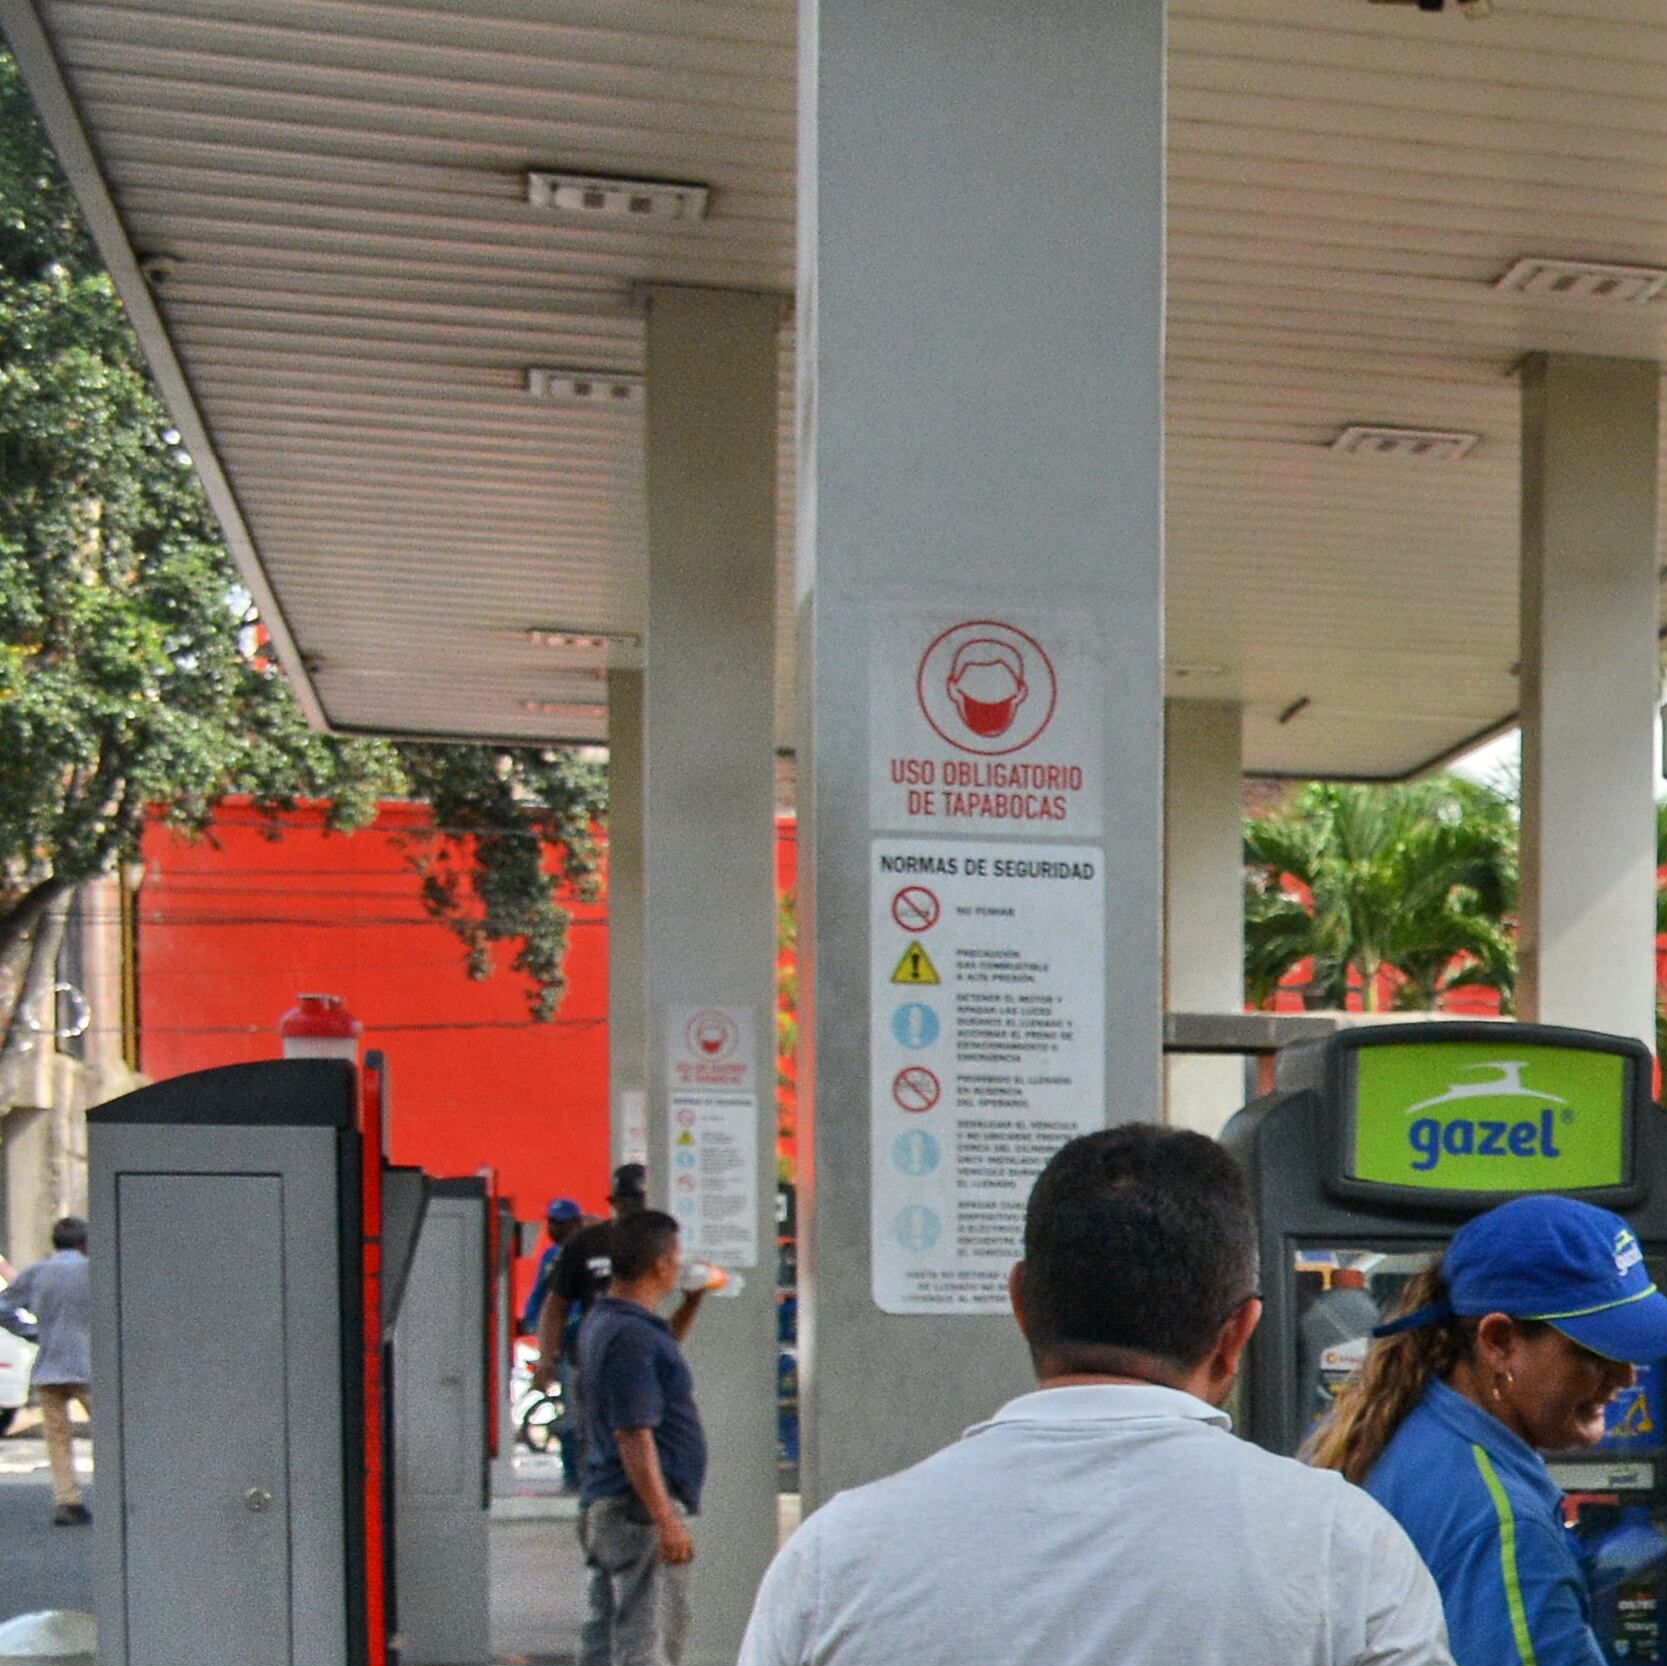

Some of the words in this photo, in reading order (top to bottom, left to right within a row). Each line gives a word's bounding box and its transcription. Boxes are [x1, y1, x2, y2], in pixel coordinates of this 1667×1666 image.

[890, 759, 935, 786] USO
[943, 762, 1083, 790] OBLIGATORIO
[908, 791, 935, 816] DE
[943, 792, 1067, 821] TAPABOCAS
[880, 855, 958, 877] NORMAS
[965, 858, 987, 877] DE
[994, 860, 1095, 881] SEGURIDAD
[1409, 1109, 1560, 1171] gazel
